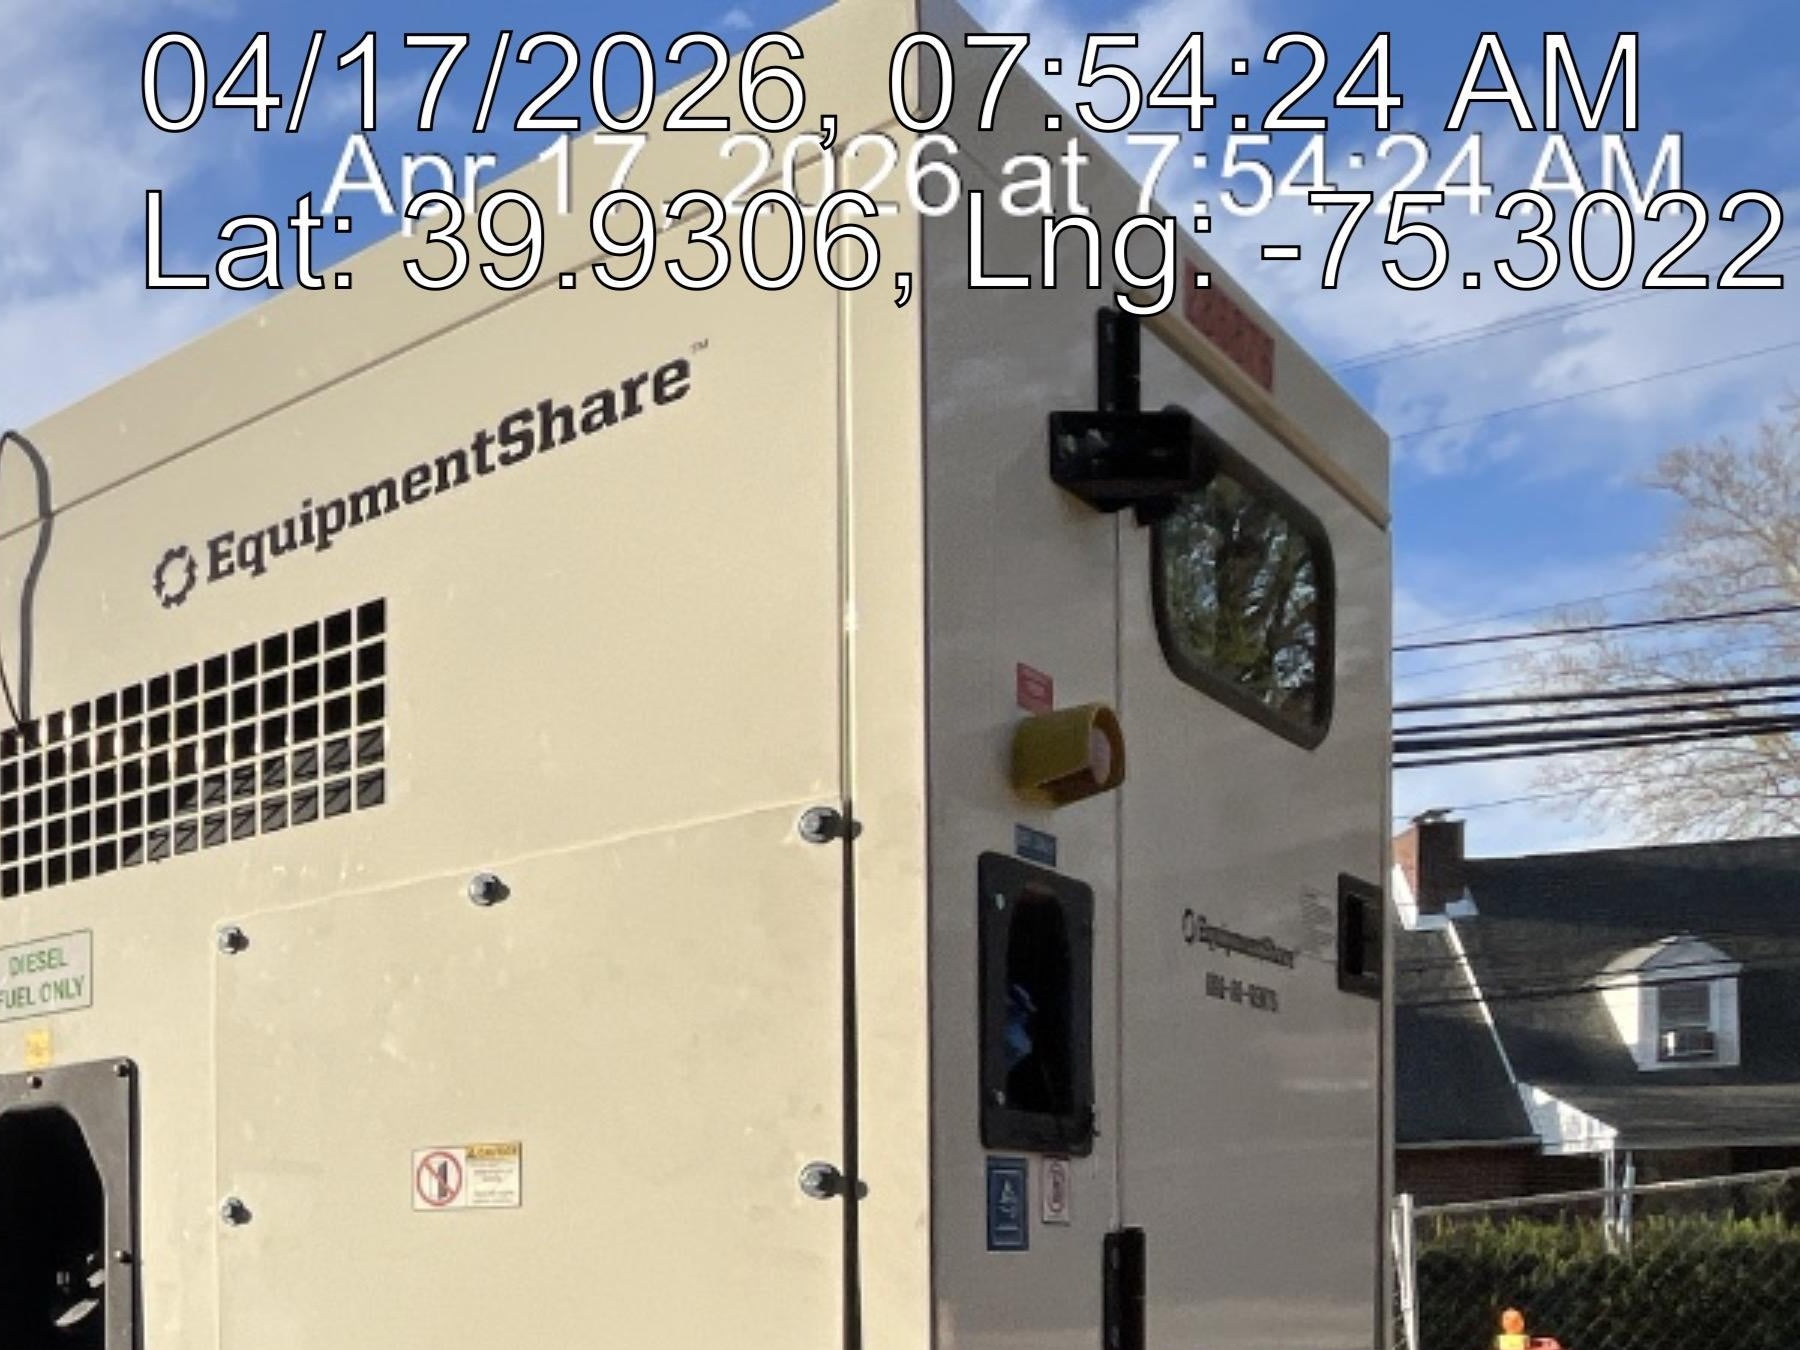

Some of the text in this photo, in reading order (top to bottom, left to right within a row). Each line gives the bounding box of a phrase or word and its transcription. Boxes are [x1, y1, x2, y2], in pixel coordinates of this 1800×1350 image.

[206, 355, 691, 584] EquipmentShare
[8, 947, 69, 977] DIESEL
[39, 974, 85, 1003] ONLY
